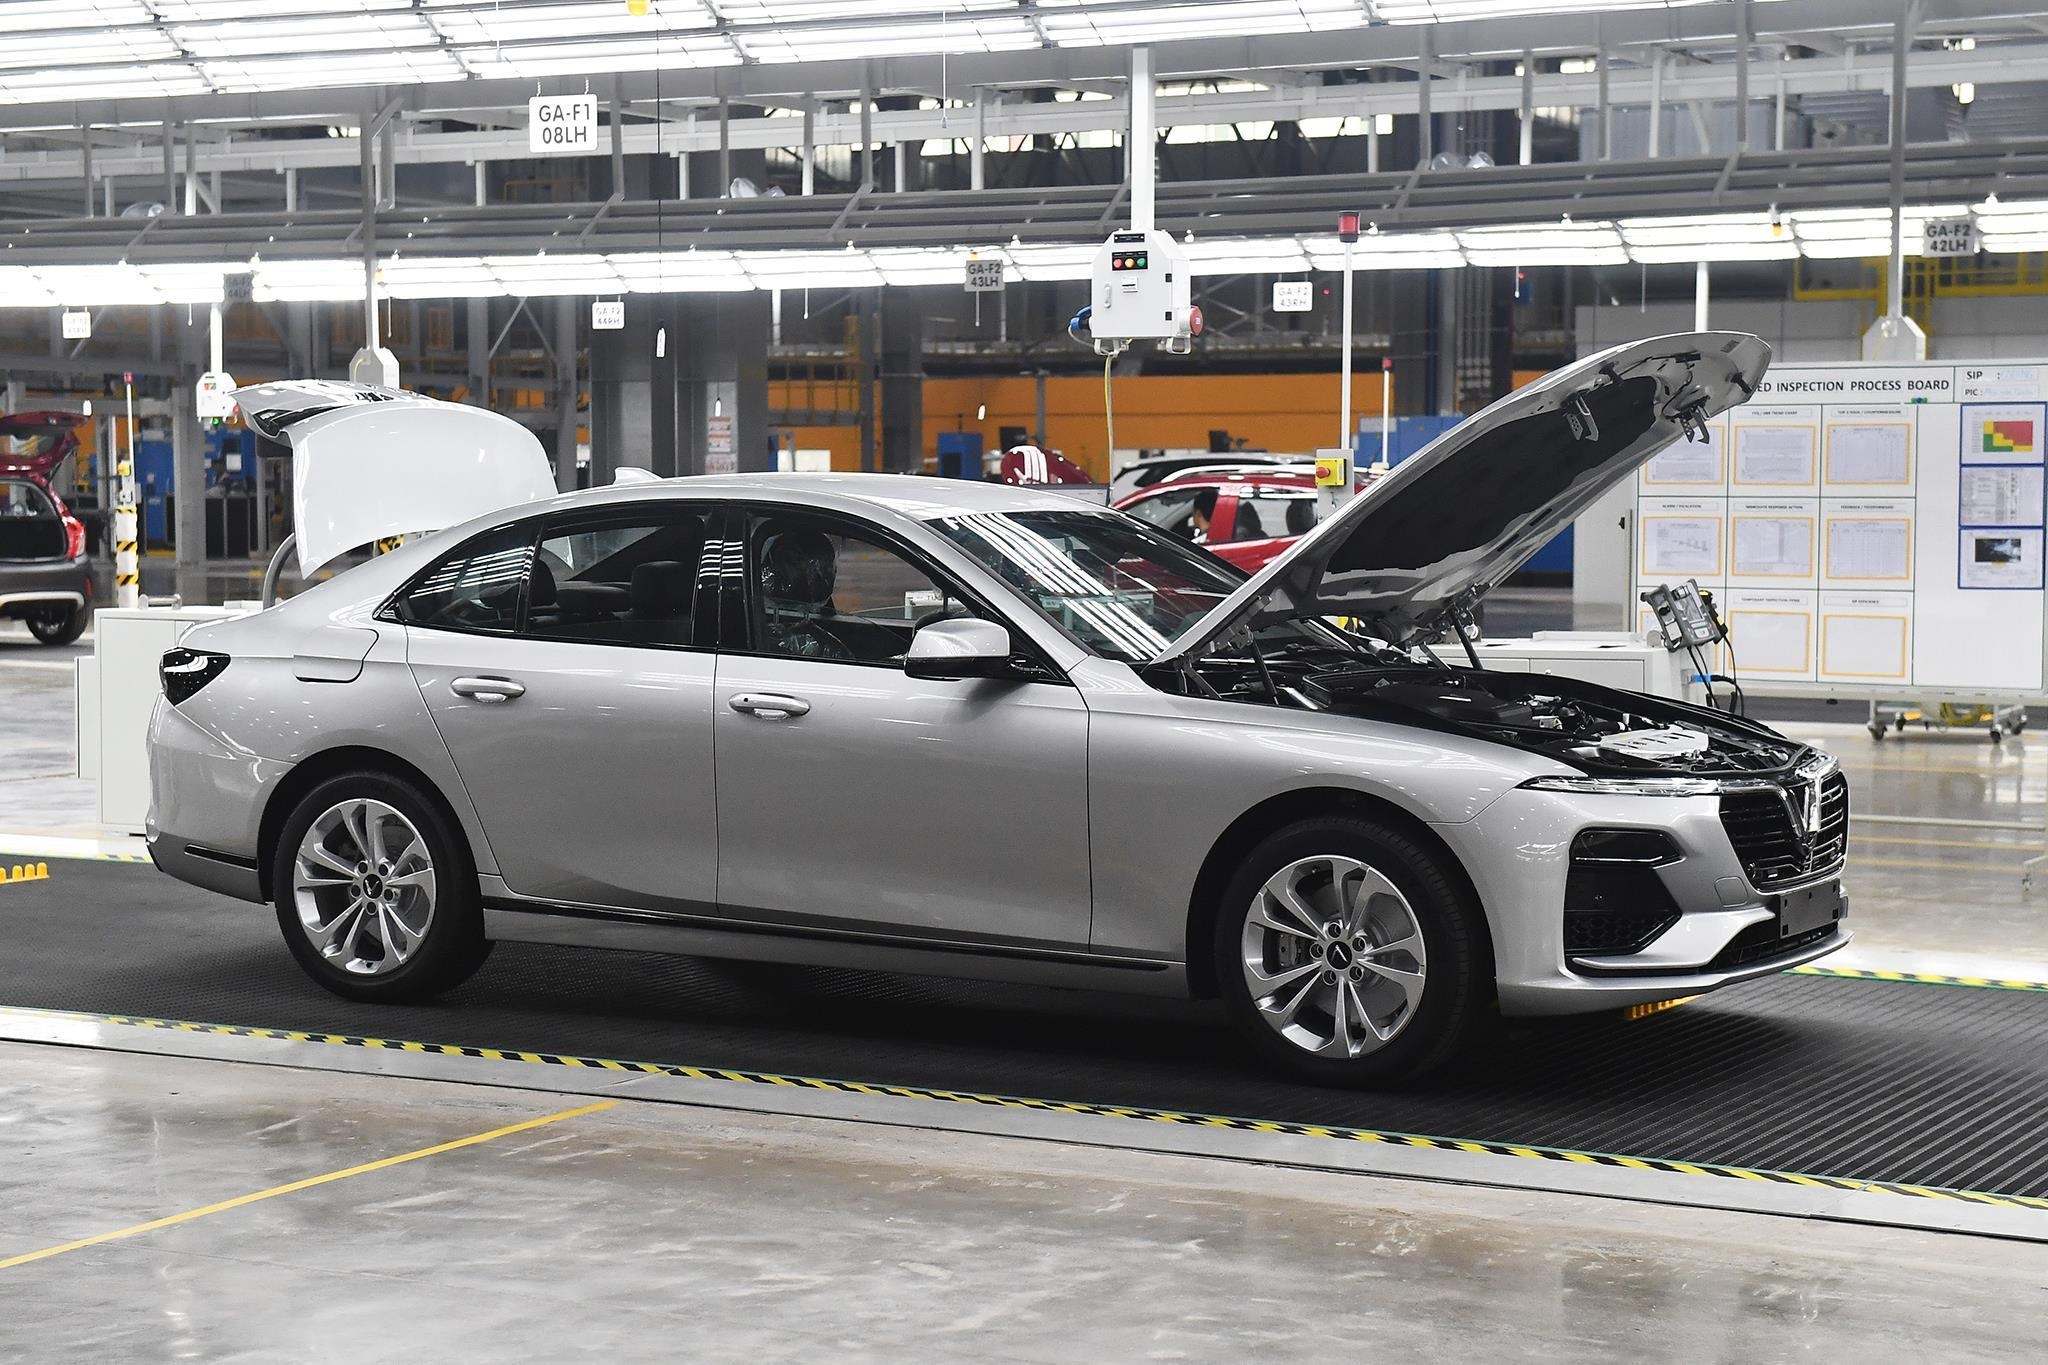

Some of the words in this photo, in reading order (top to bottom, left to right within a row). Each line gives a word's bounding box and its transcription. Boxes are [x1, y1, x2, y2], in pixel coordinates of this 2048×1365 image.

[539, 103, 590, 123] GA-F1
[543, 126, 587, 144] 08LH
[1927, 224, 1971, 239] GA-F2
[1930, 239, 1967, 252] 42LH
[968, 263, 1002, 275] GA-F2
[971, 276, 999, 287] 43LH
[1966, 371, 1983, 380] SIP
[1757, 382, 1772, 393] ED
[1776, 381, 1844, 393] INSPECTION
[1850, 380, 1902, 392] PROCESS
[1907, 379, 1950, 391] BOARD
[1964, 388, 1979, 397] PIC
